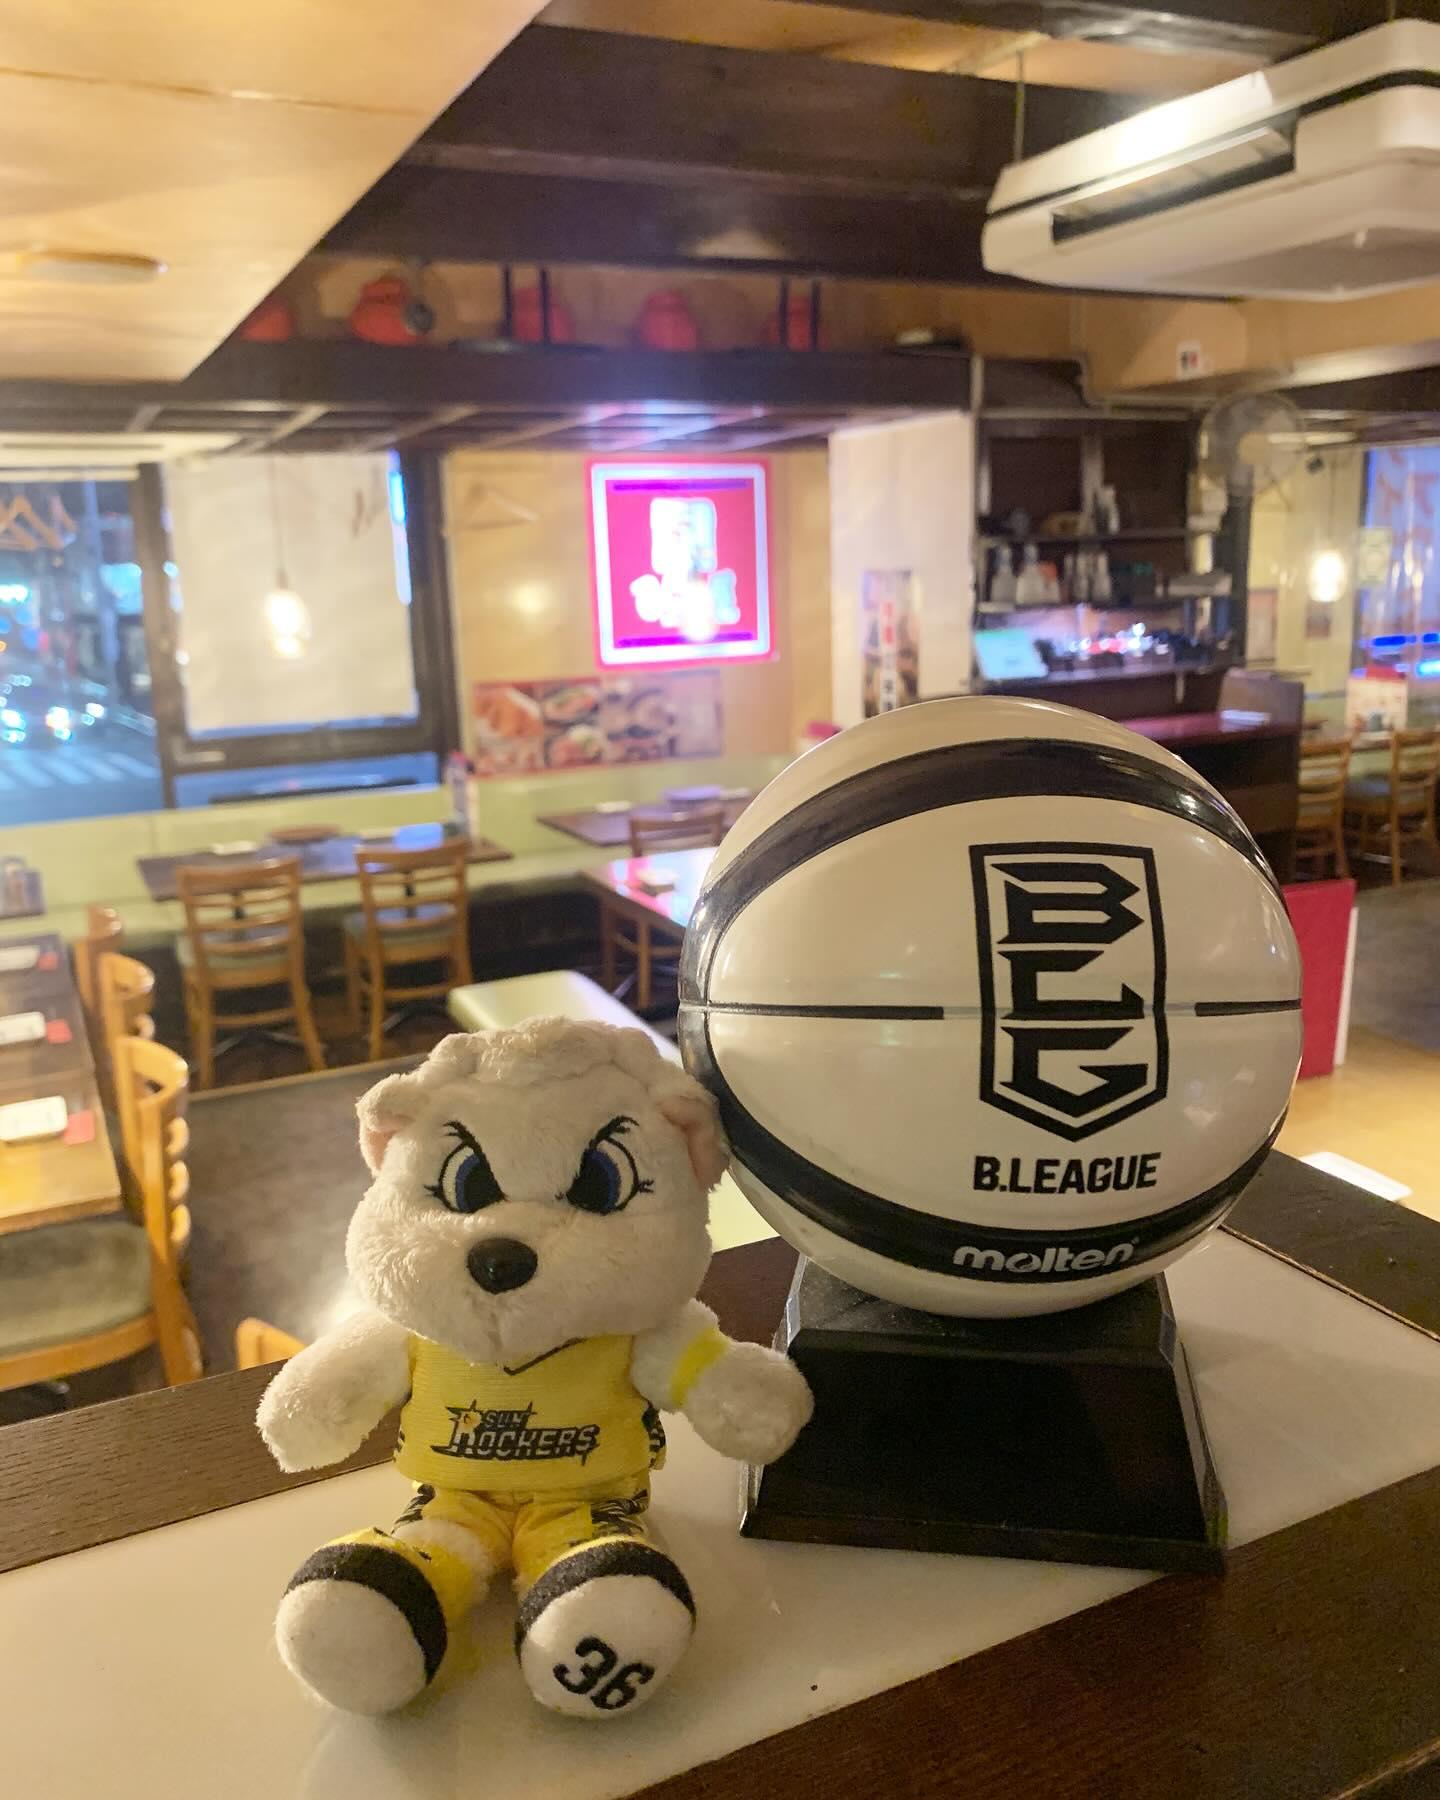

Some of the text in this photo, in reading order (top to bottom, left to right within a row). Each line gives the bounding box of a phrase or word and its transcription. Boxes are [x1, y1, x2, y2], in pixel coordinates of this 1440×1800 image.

[973, 1152, 1162, 1194] B.LEAGUE
[953, 1242, 1135, 1273] molten
[440, 1409, 599, 1459] ROCKERS
[484, 1410, 530, 1429] SUN
[552, 1634, 656, 1710] 36
